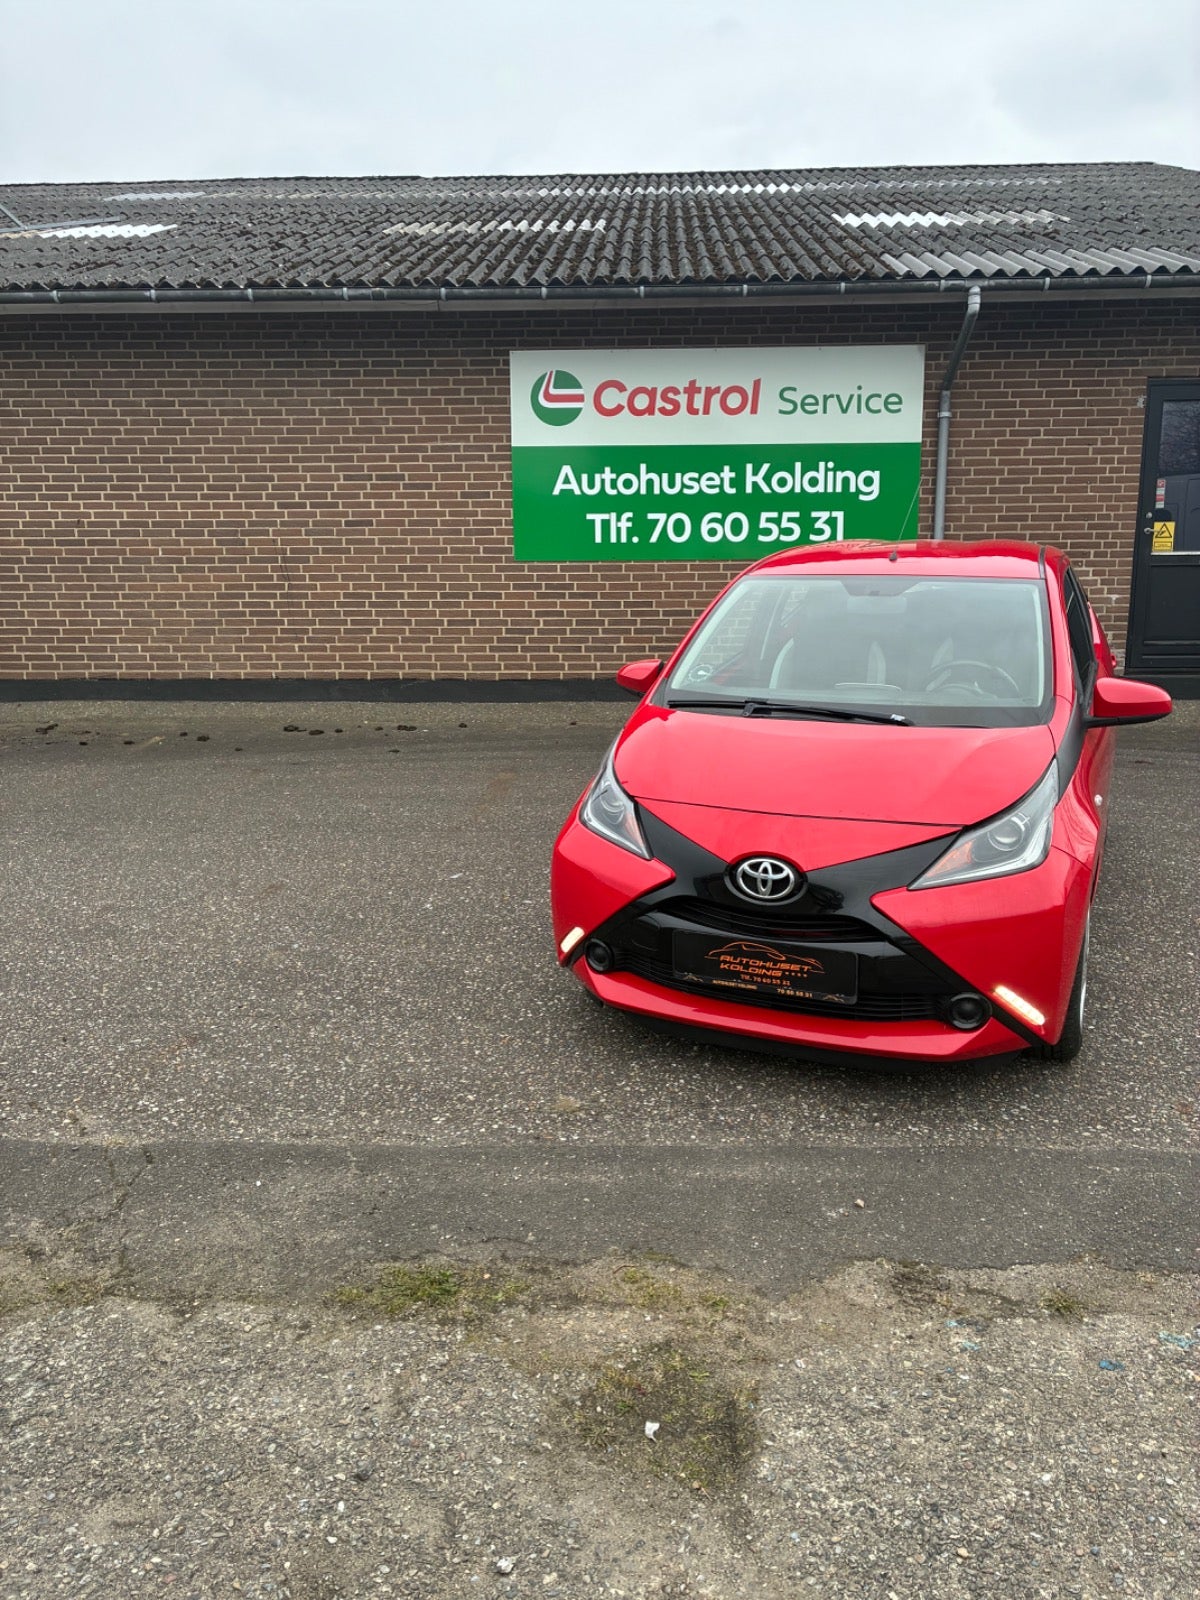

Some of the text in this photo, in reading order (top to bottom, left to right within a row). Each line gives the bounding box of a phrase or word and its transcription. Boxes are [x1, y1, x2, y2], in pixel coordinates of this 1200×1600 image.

[593, 378, 903, 417] Castrol Service
[552, 461, 881, 502] Autohuset Kolding
[586, 511, 845, 544] Tlf. 70 60 55 31
[719, 955, 810, 972] AUTOHUSET
[720, 963, 782, 976] KOLDING
